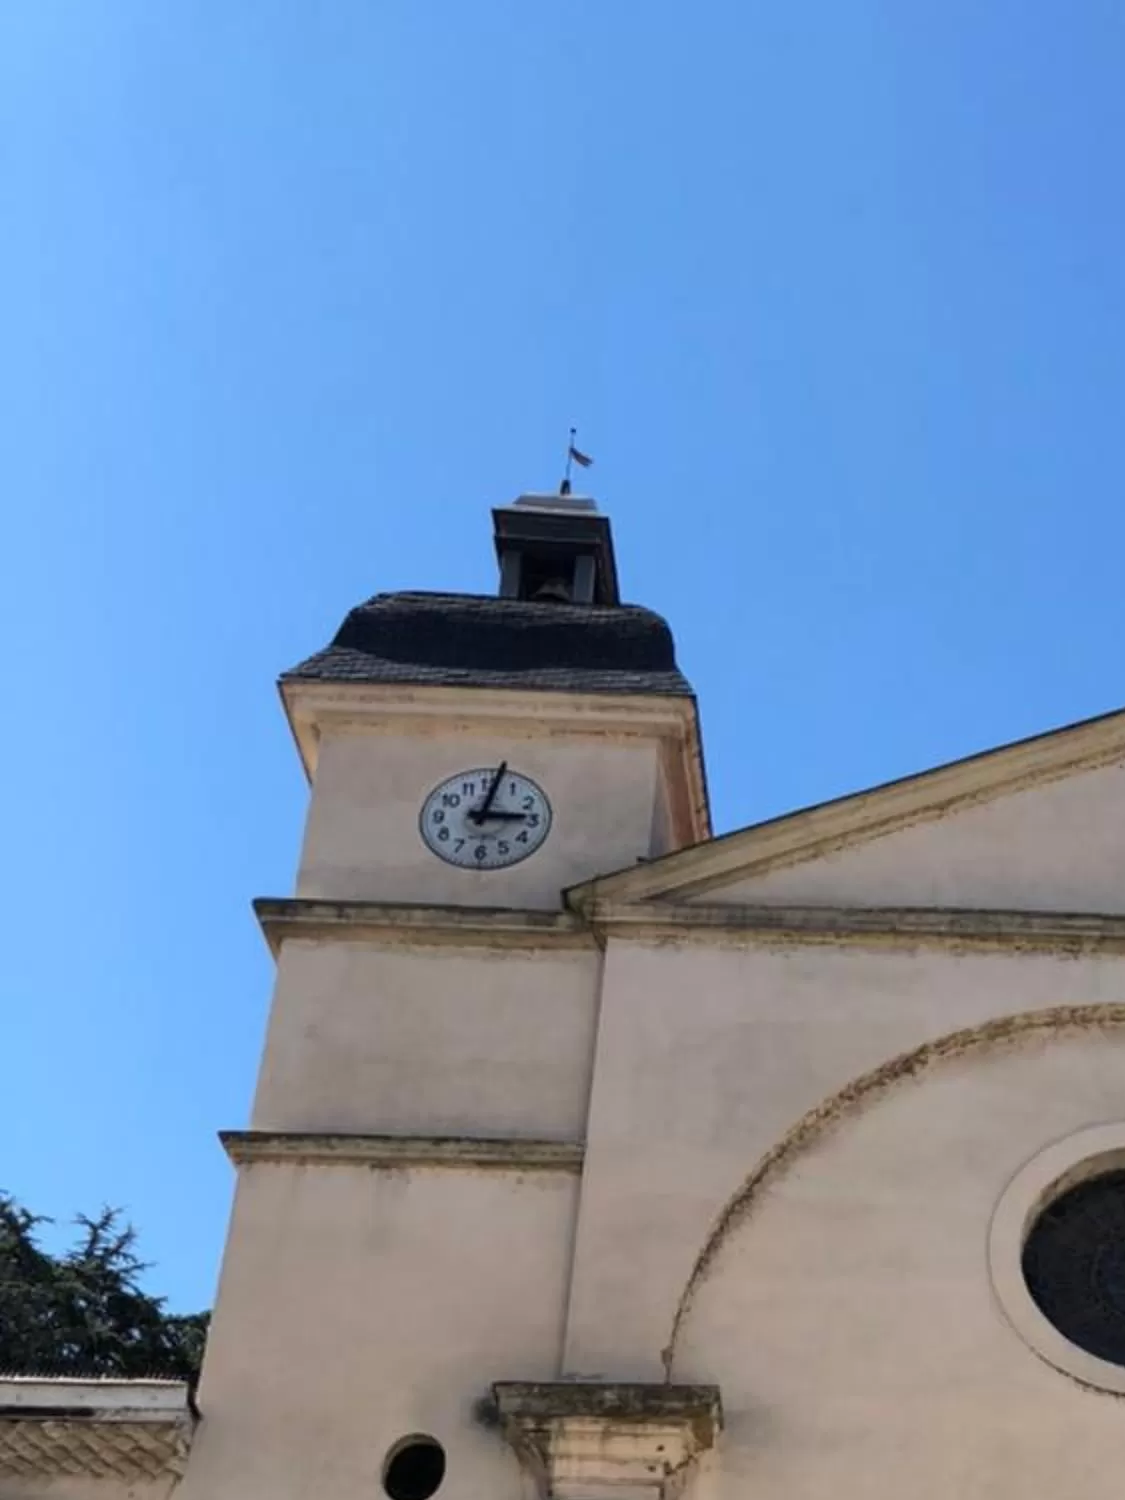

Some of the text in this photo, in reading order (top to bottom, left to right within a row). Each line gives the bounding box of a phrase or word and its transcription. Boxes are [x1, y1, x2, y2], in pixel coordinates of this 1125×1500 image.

[462, 783, 475, 796] 11
[481, 778, 497, 792] 1
[510, 782, 516, 796] 1
[442, 793, 460, 808] 10
[522, 796, 534, 811] 2
[433, 810, 445, 824] 9
[526, 814, 539, 828] 3
[515, 831, 528, 844] 4
[454, 838, 465, 853] 7
[474, 845, 487, 860] 6
[498, 840, 509, 855] 5
